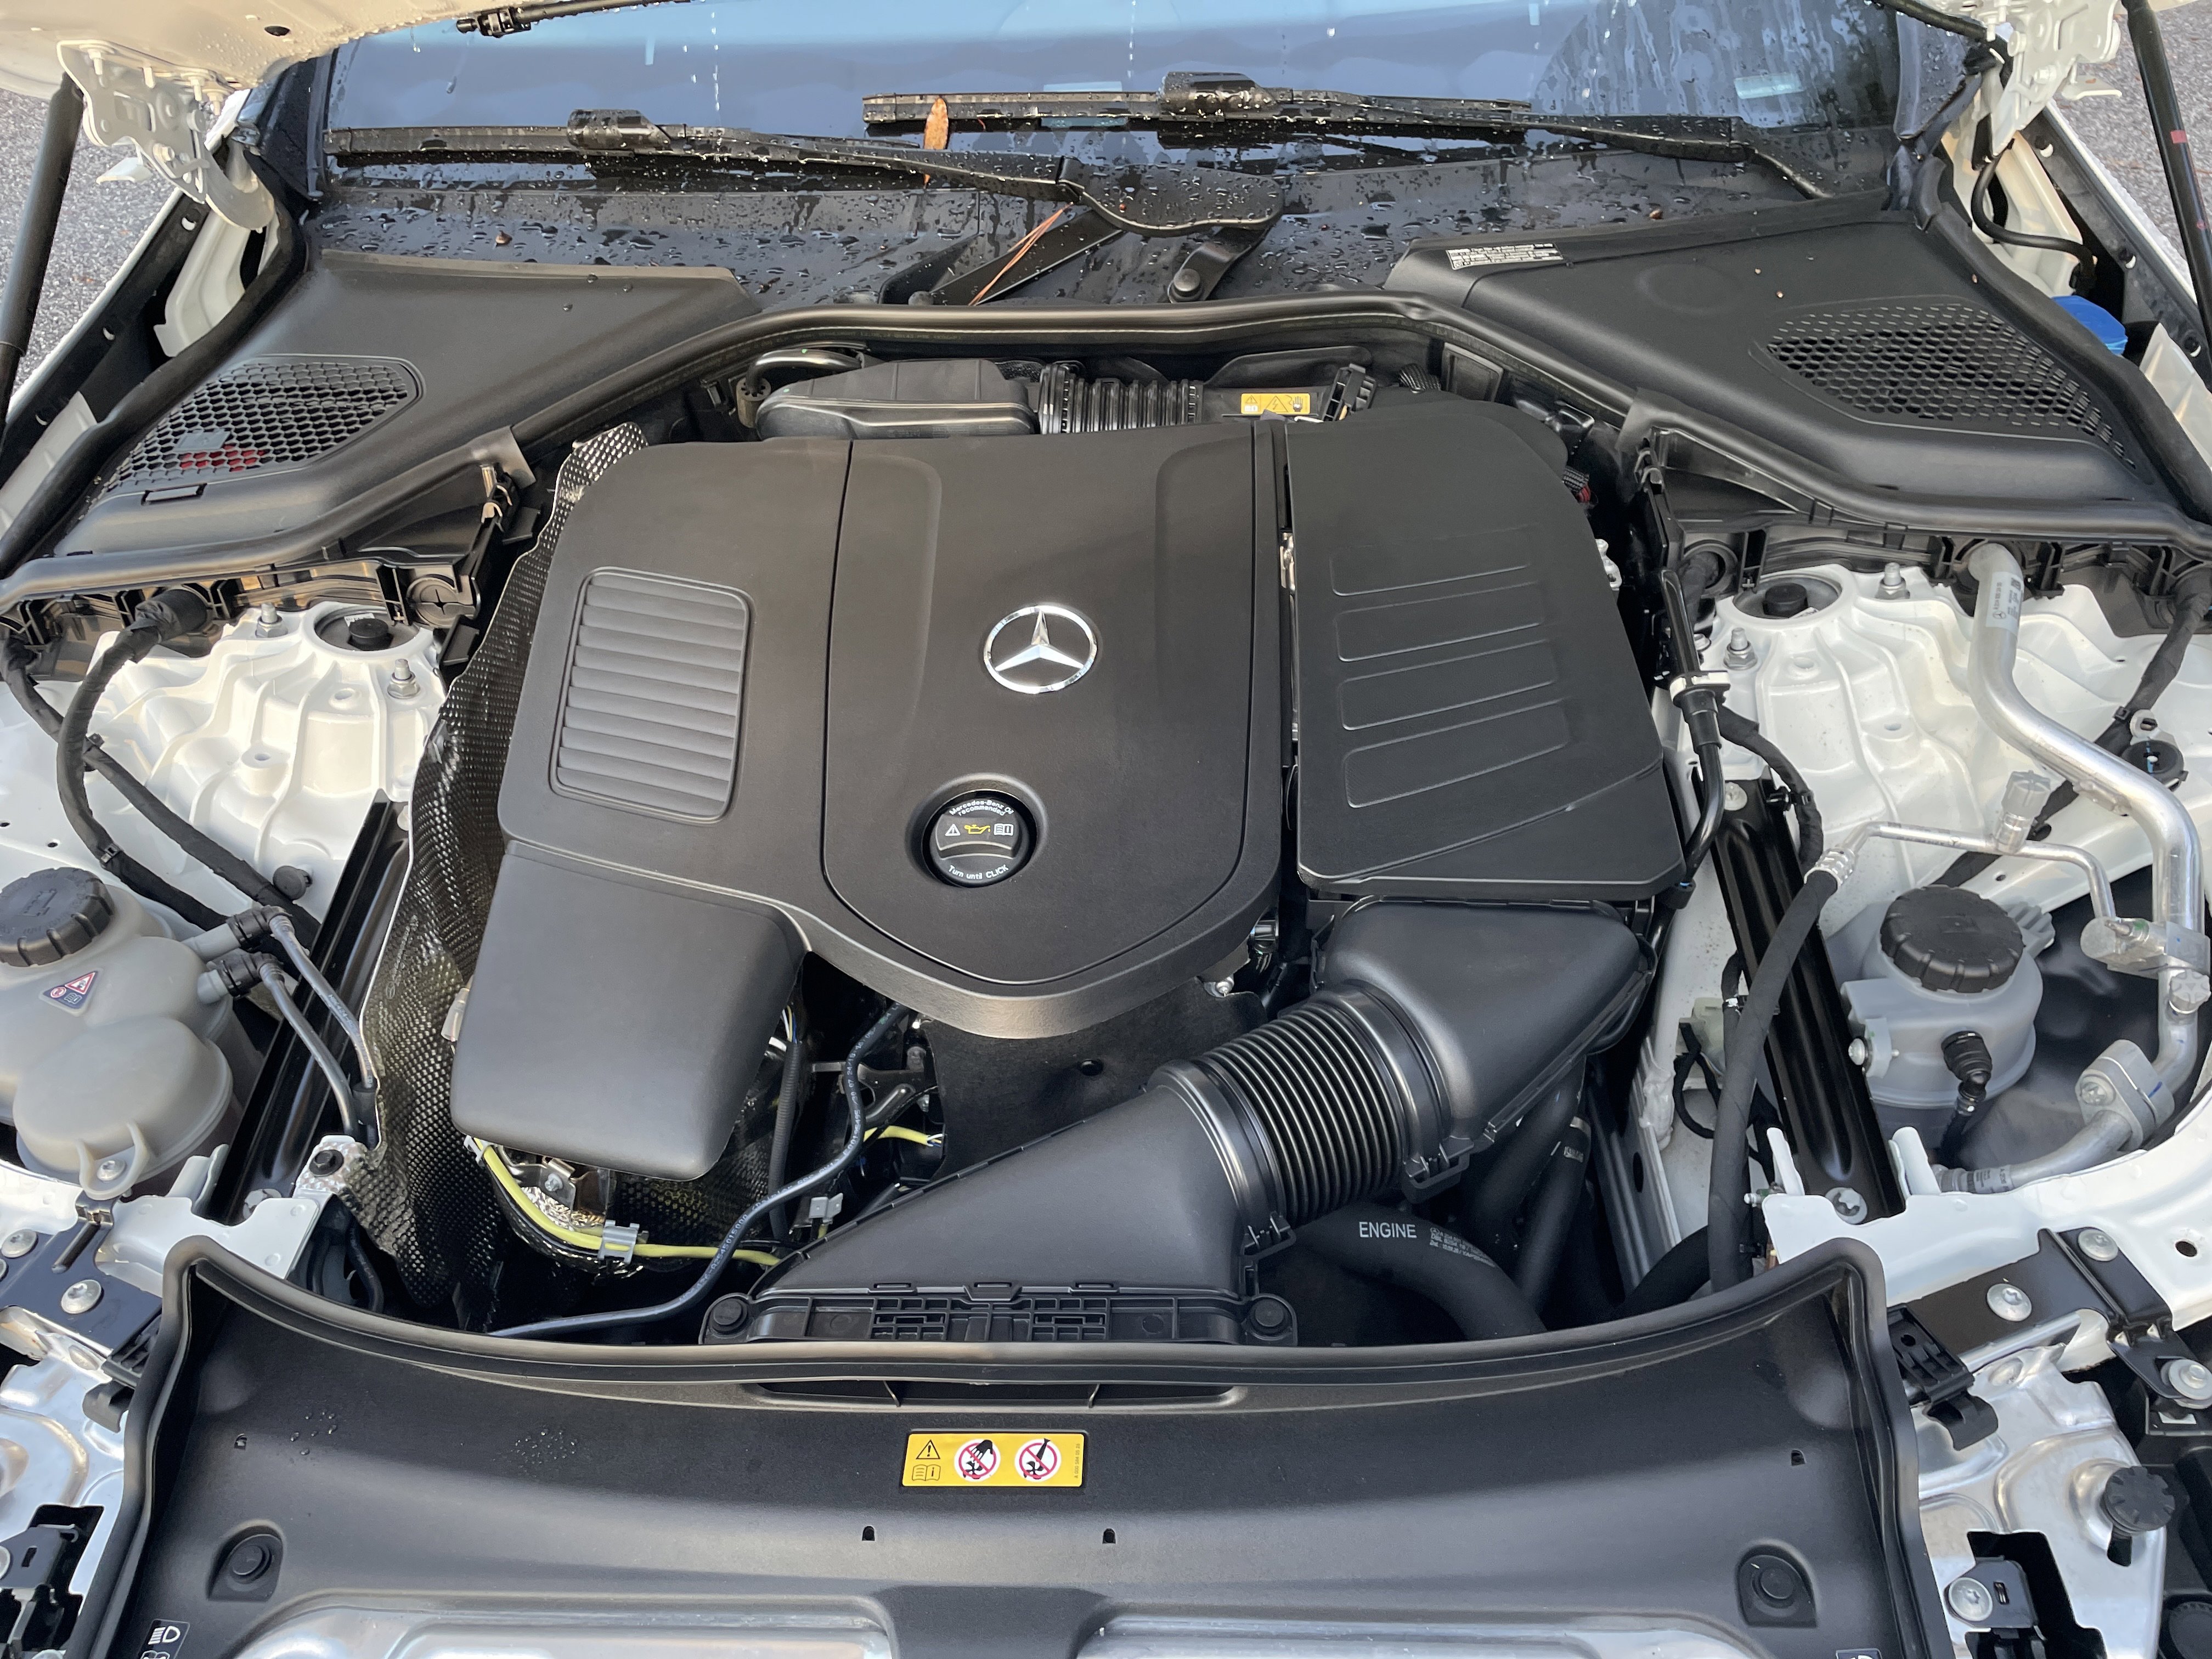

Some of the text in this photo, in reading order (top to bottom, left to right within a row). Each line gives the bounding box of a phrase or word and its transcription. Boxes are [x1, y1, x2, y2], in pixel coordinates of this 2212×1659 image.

[949, 799, 1003, 815] Mercedes-Benz
[958, 805, 1006, 816] recommended
[949, 865, 963, 877] Turn
[986, 864, 1009, 878] CLICK
[1359, 1221, 1417, 1239] ENGINE
